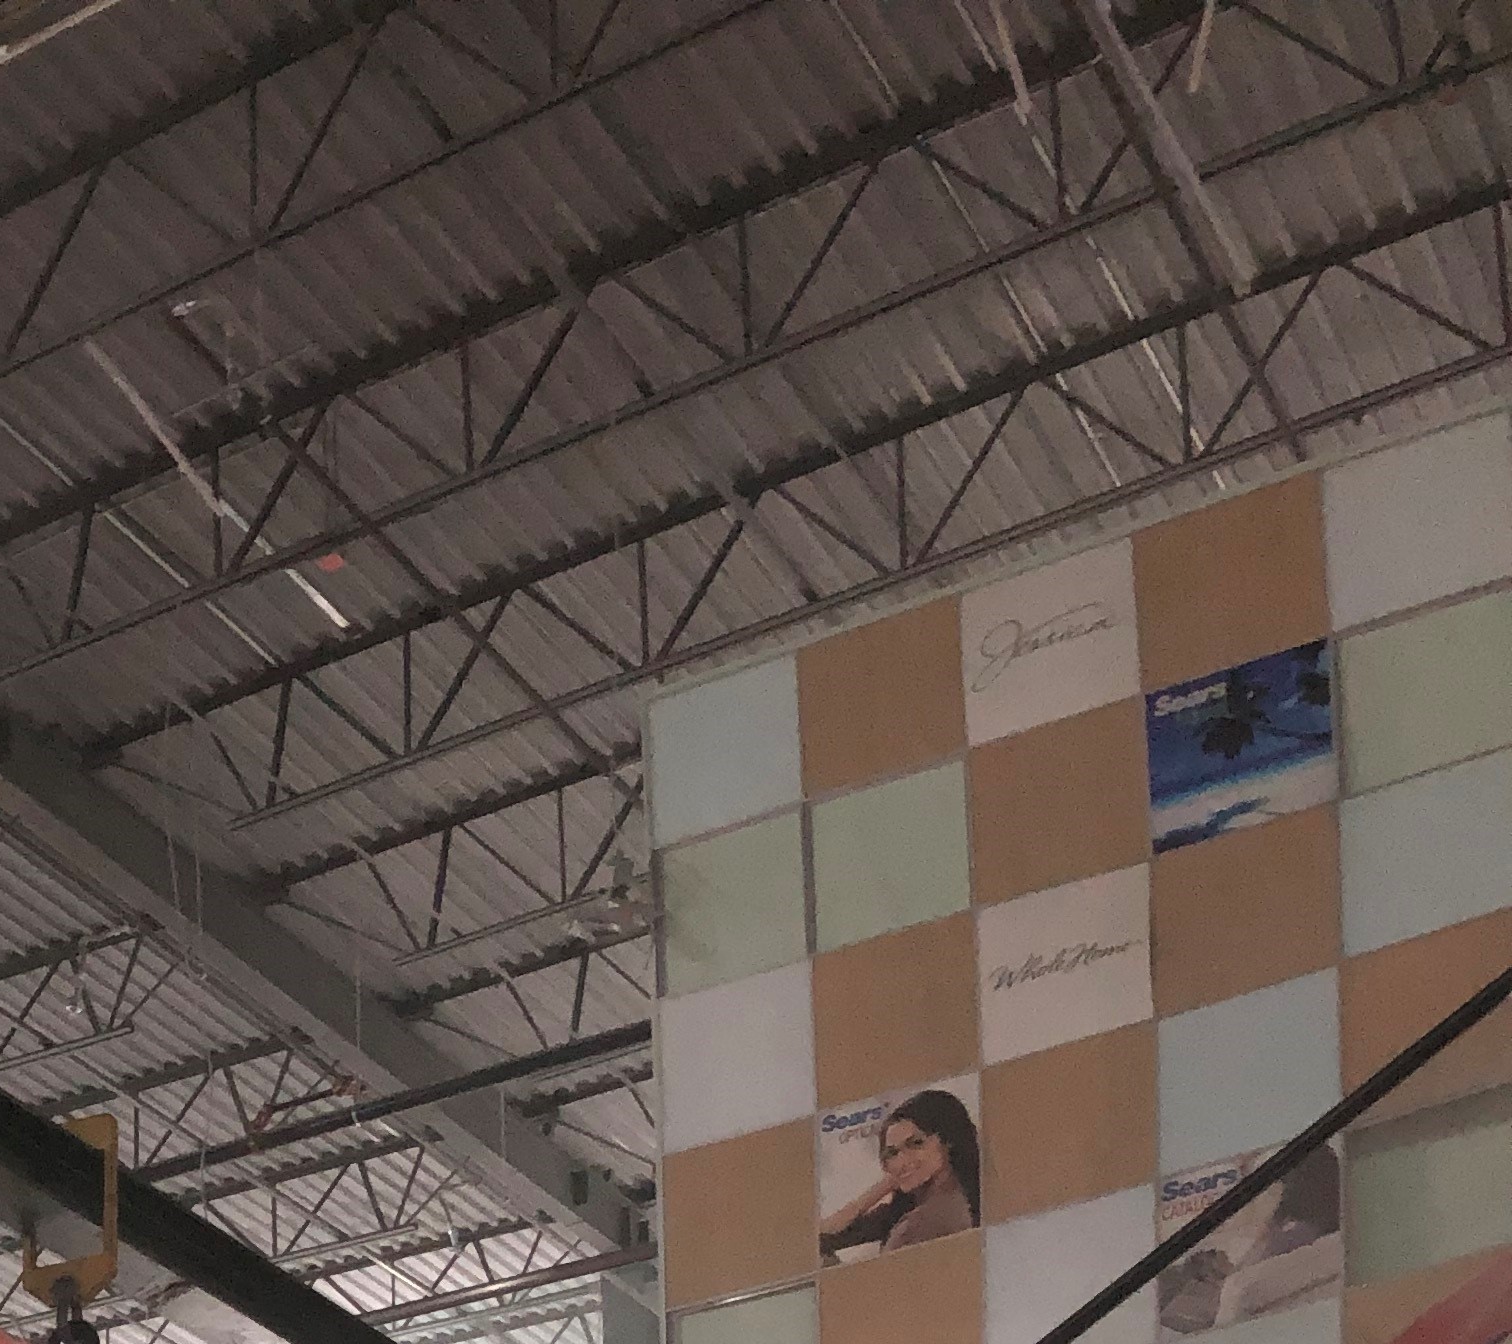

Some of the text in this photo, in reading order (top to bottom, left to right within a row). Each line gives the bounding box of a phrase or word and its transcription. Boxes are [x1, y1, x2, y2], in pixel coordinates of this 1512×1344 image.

[1154, 682, 1228, 717] Sears
[821, 1106, 883, 1133] Sears
[1160, 1168, 1239, 1202] Sears
